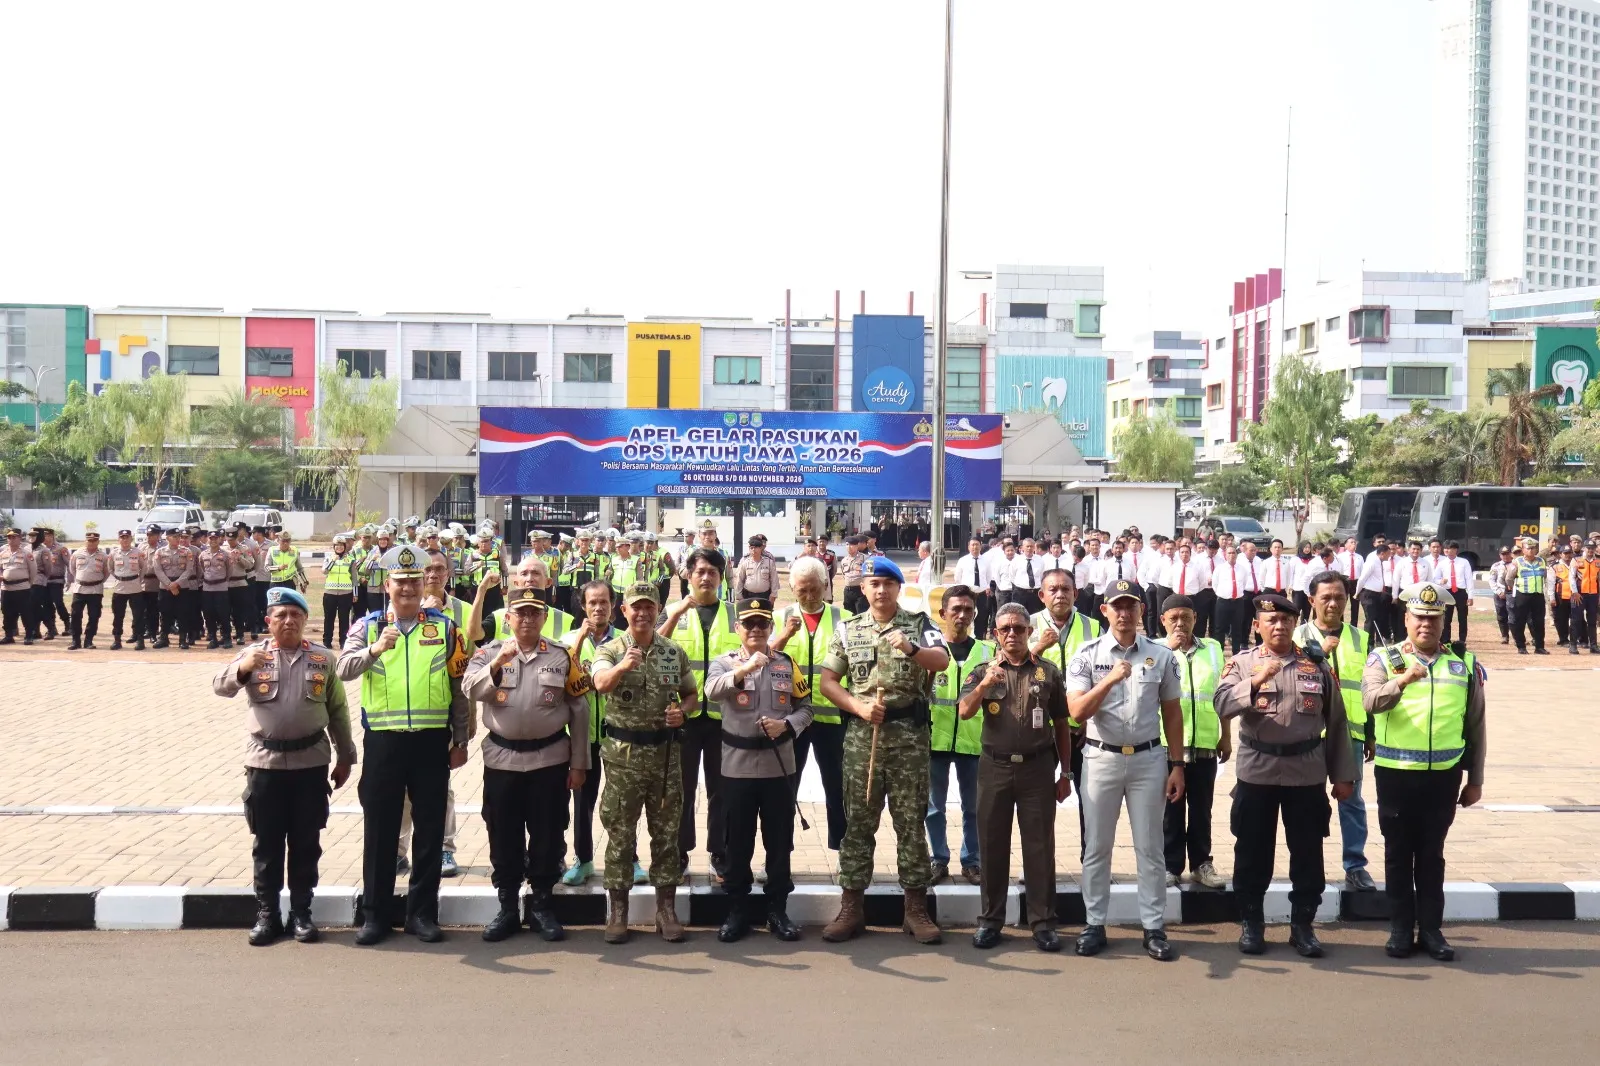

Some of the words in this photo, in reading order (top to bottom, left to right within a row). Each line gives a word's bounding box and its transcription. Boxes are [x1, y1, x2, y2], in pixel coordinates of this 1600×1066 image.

[867, 380, 910, 405] Audy
[628, 427, 682, 443] APEL
[687, 427, 757, 445] GELAR
[761, 429, 858, 446] PASUKAN
[622, 443, 666, 460] OPS
[670, 444, 739, 461] PATUH
[743, 445, 797, 463] JAYA
[813, 446, 862, 463] 2026
[621, 462, 649, 470] Bersama
[650, 462, 685, 471] Masyarakat
[686, 463, 725, 472] Mewujudkan
[727, 464, 740, 472] Lalu
[741, 464, 760, 472] Lintas
[762, 464, 777, 473] Yang
[799, 465, 817, 473] Aman
[818, 465, 831, 473] Dan
[725, 474, 737, 482] S/D
[748, 475, 785, 483] NOVEMBER
[786, 475, 802, 483] 2026
[657, 485, 689, 494] POLRES
[690, 485, 754, 495] METROPOLITAN
[755, 487, 805, 496] TANGERANG
[1519, 524, 1567, 535] POSI
[924, 630, 944, 647] P
[307, 662, 329, 670] POLRI
[770, 672, 792, 680] POLRI
